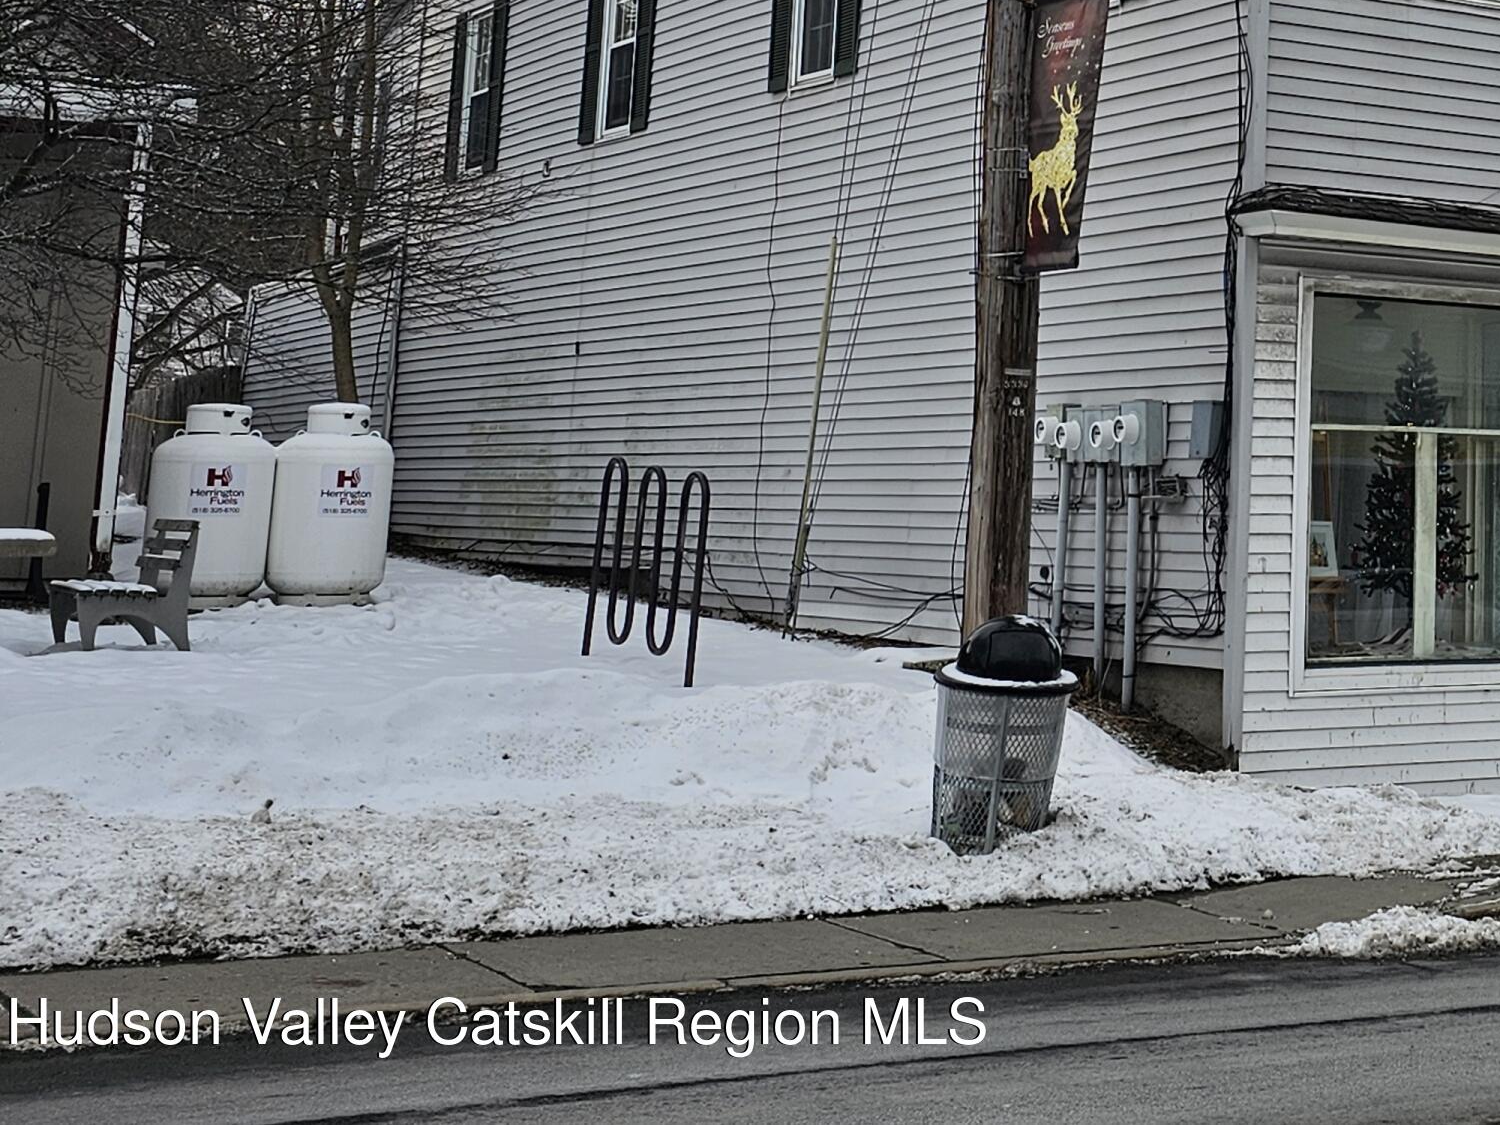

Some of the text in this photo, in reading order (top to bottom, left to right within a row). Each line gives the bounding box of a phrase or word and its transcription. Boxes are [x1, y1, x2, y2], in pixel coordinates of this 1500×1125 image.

[190, 488, 245, 498] Herrington
[320, 489, 372, 499] Herrington
[209, 497, 238, 505] Fuels
[339, 498, 366, 506] Fuels
